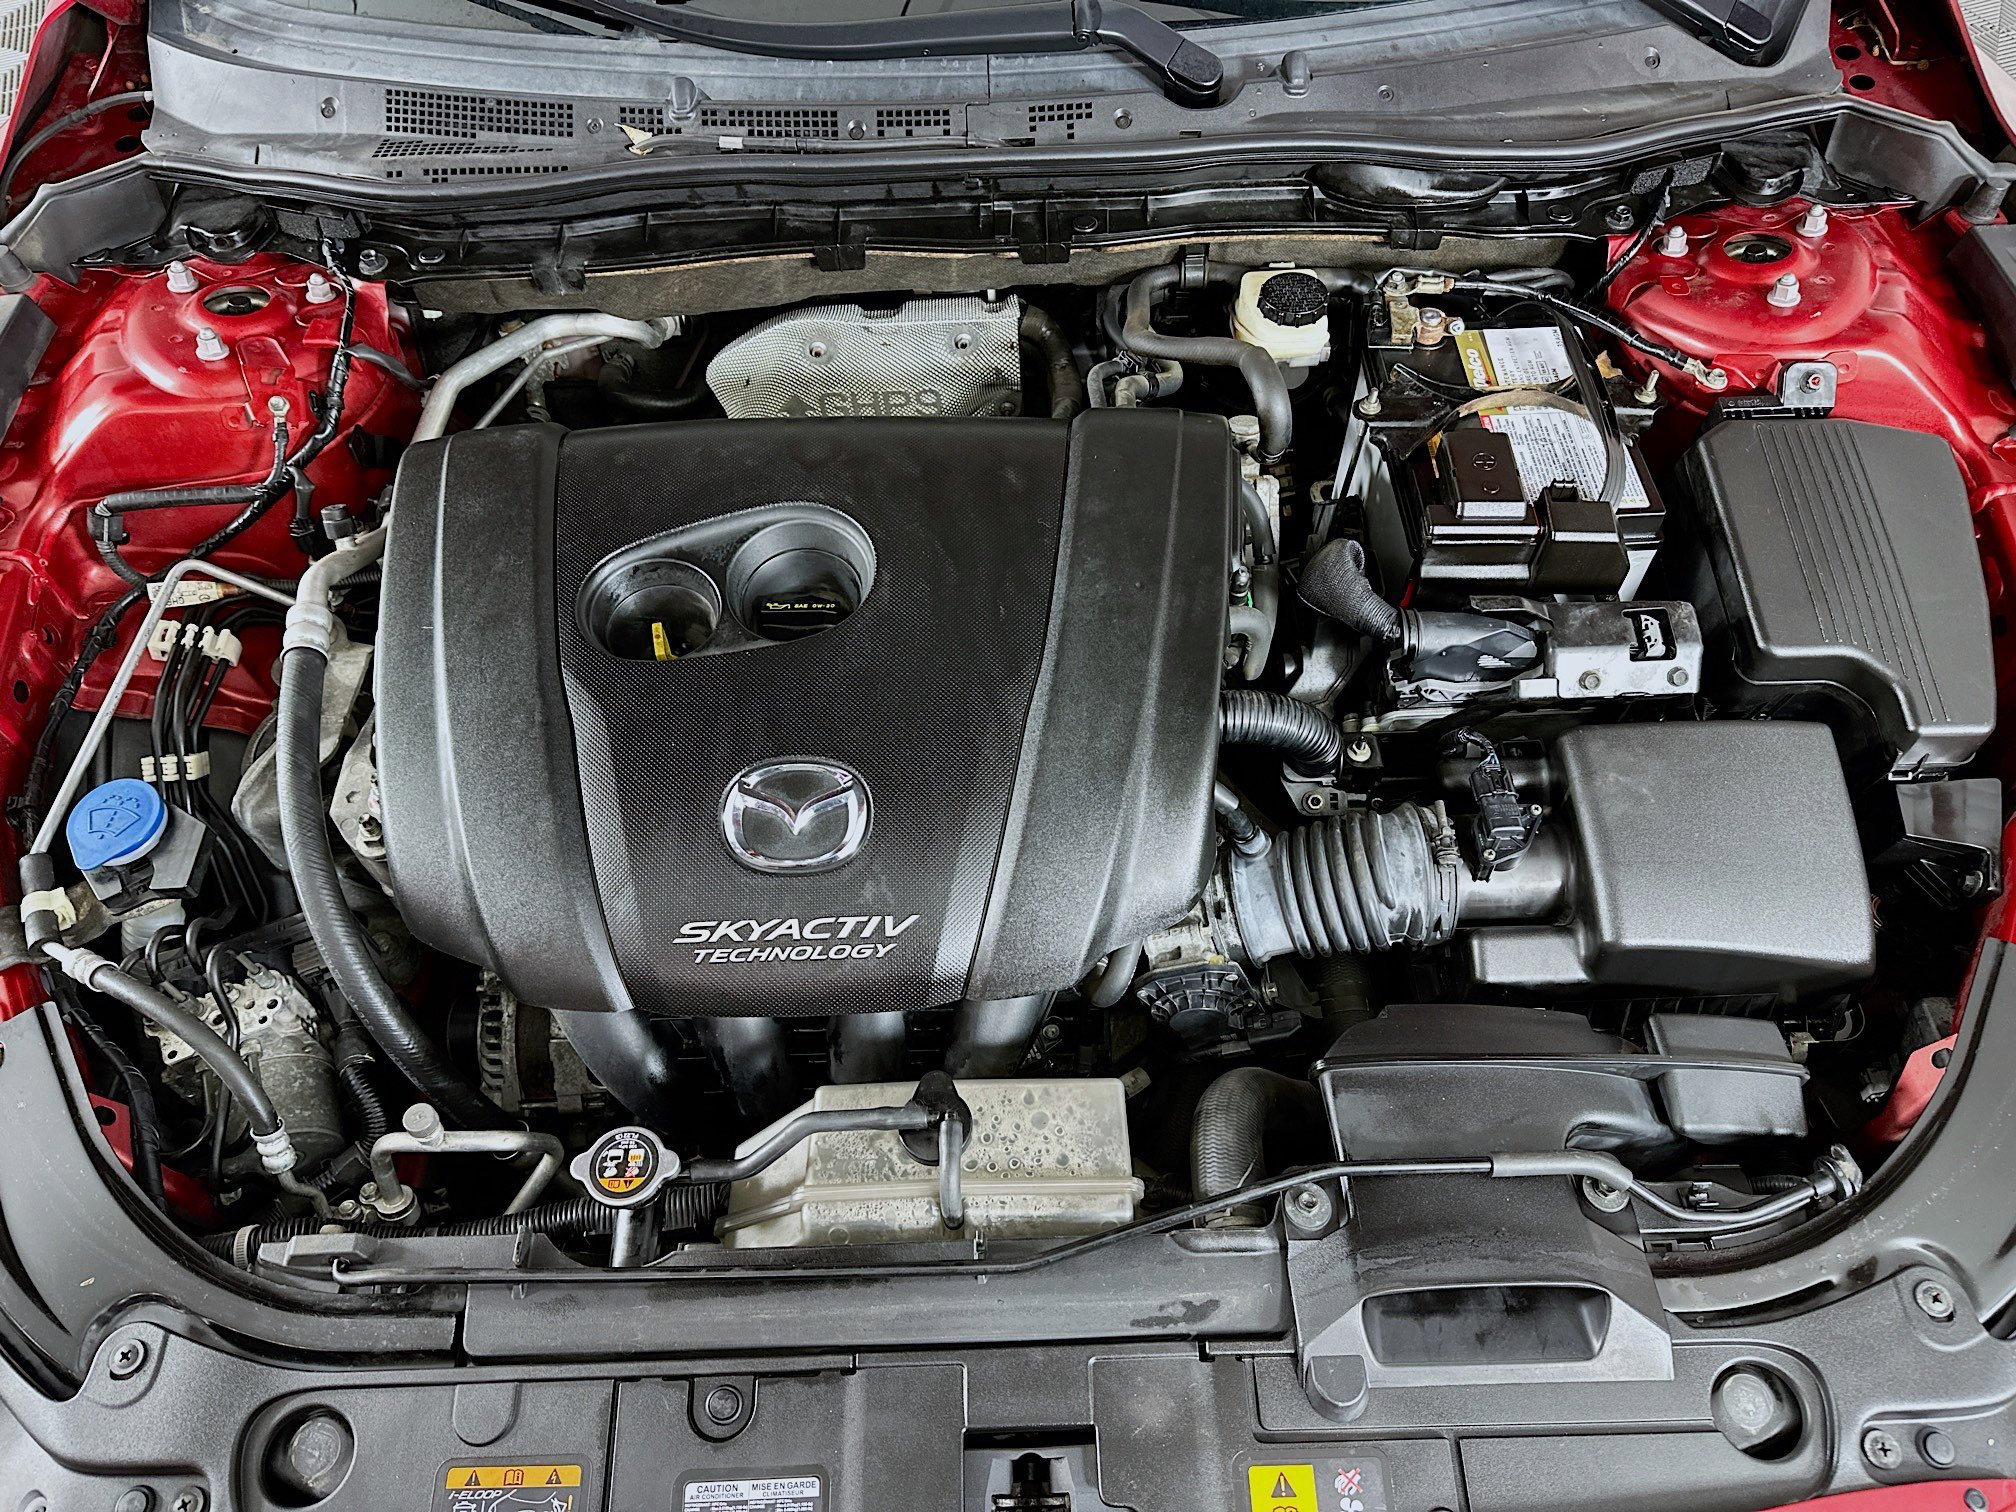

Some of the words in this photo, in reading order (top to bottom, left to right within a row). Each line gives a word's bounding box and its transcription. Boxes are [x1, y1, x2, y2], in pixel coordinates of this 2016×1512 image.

[672, 914, 921, 944] SKYACTIV
[694, 943, 898, 964] TECHNOLOGY
[696, 1484, 738, 1494] CAUTION
[752, 1482, 772, 1491] MISE
[774, 1482, 785, 1490] EN
[787, 1480, 816, 1489] GARDE
[448, 1490, 502, 1500] i-ELOOP
